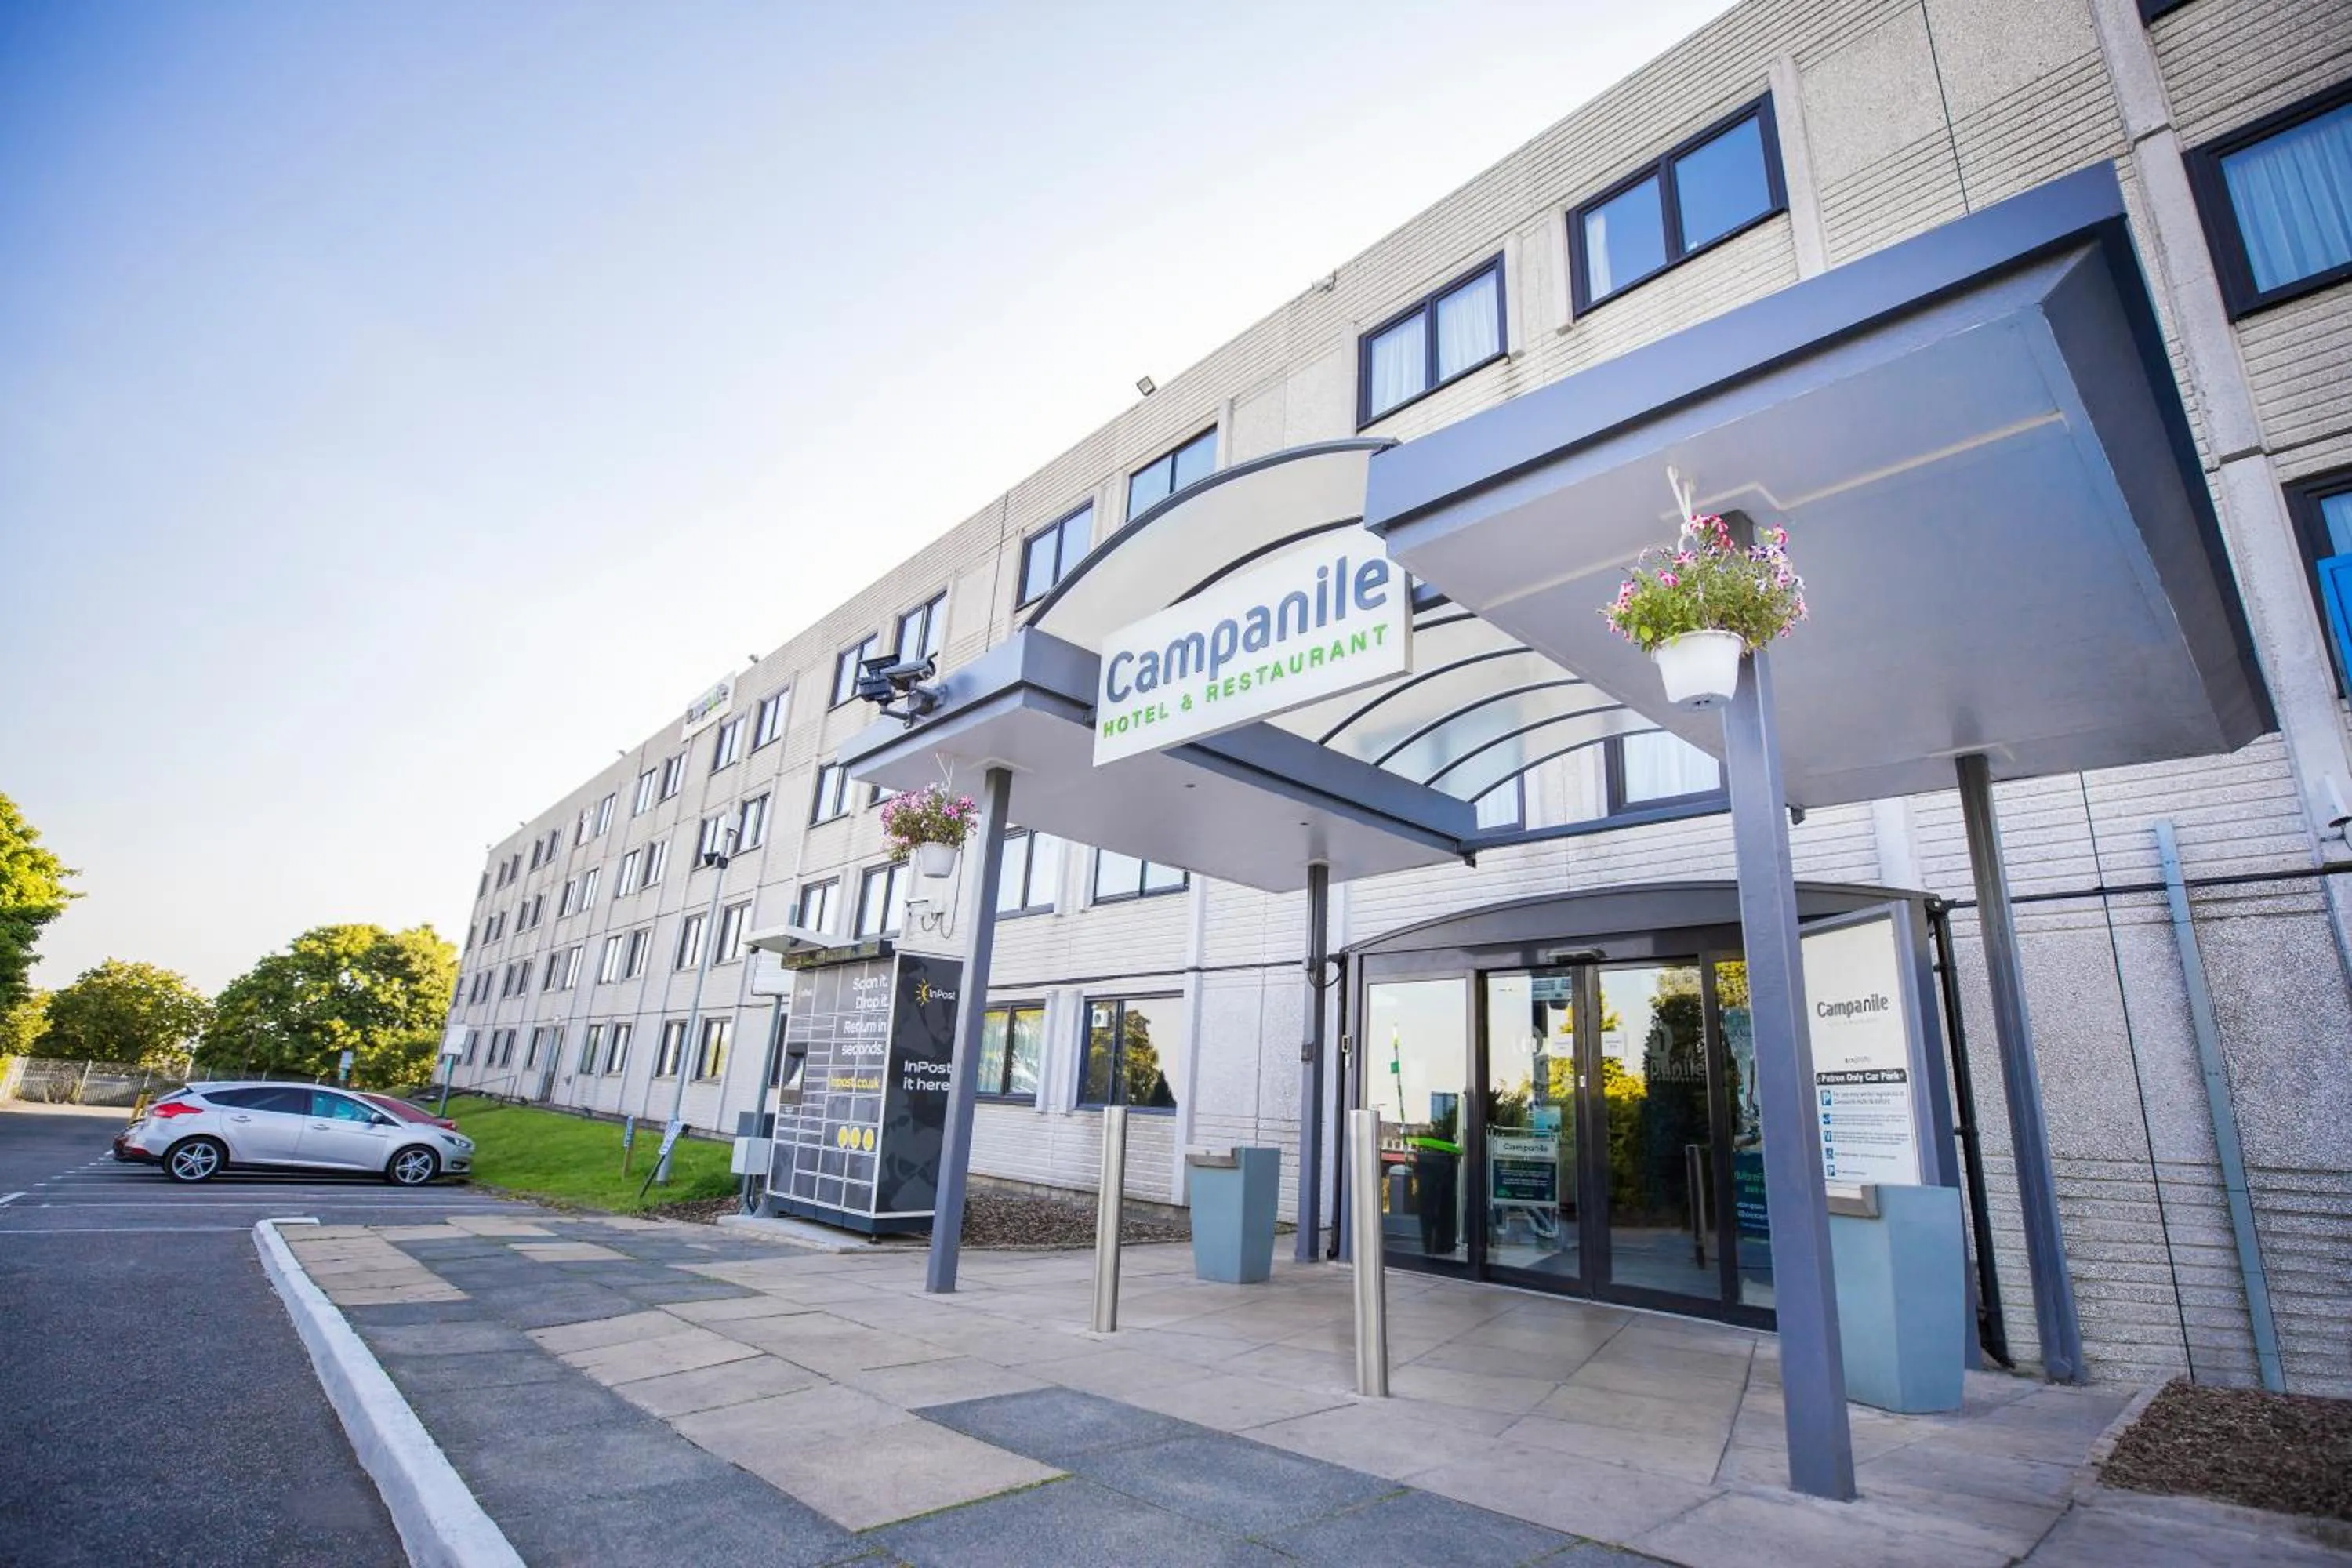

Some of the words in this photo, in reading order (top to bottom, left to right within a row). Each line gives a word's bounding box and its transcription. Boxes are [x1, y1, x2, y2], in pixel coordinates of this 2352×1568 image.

[1107, 555, 1389, 703] Campanile
[1103, 702, 1169, 739] HOTEL
[1181, 692, 1193, 711] &
[1206, 623, 1388, 702] RESTAURANT
[929, 989, 956, 1000] InPost
[1817, 993, 1889, 1018] Campanile
[904, 1060, 953, 1074] InPost
[902, 1076, 914, 1091] it
[916, 1077, 950, 1091] here
[1846, 1073, 1864, 1083] Only
[1865, 1072, 1879, 1081] Car
